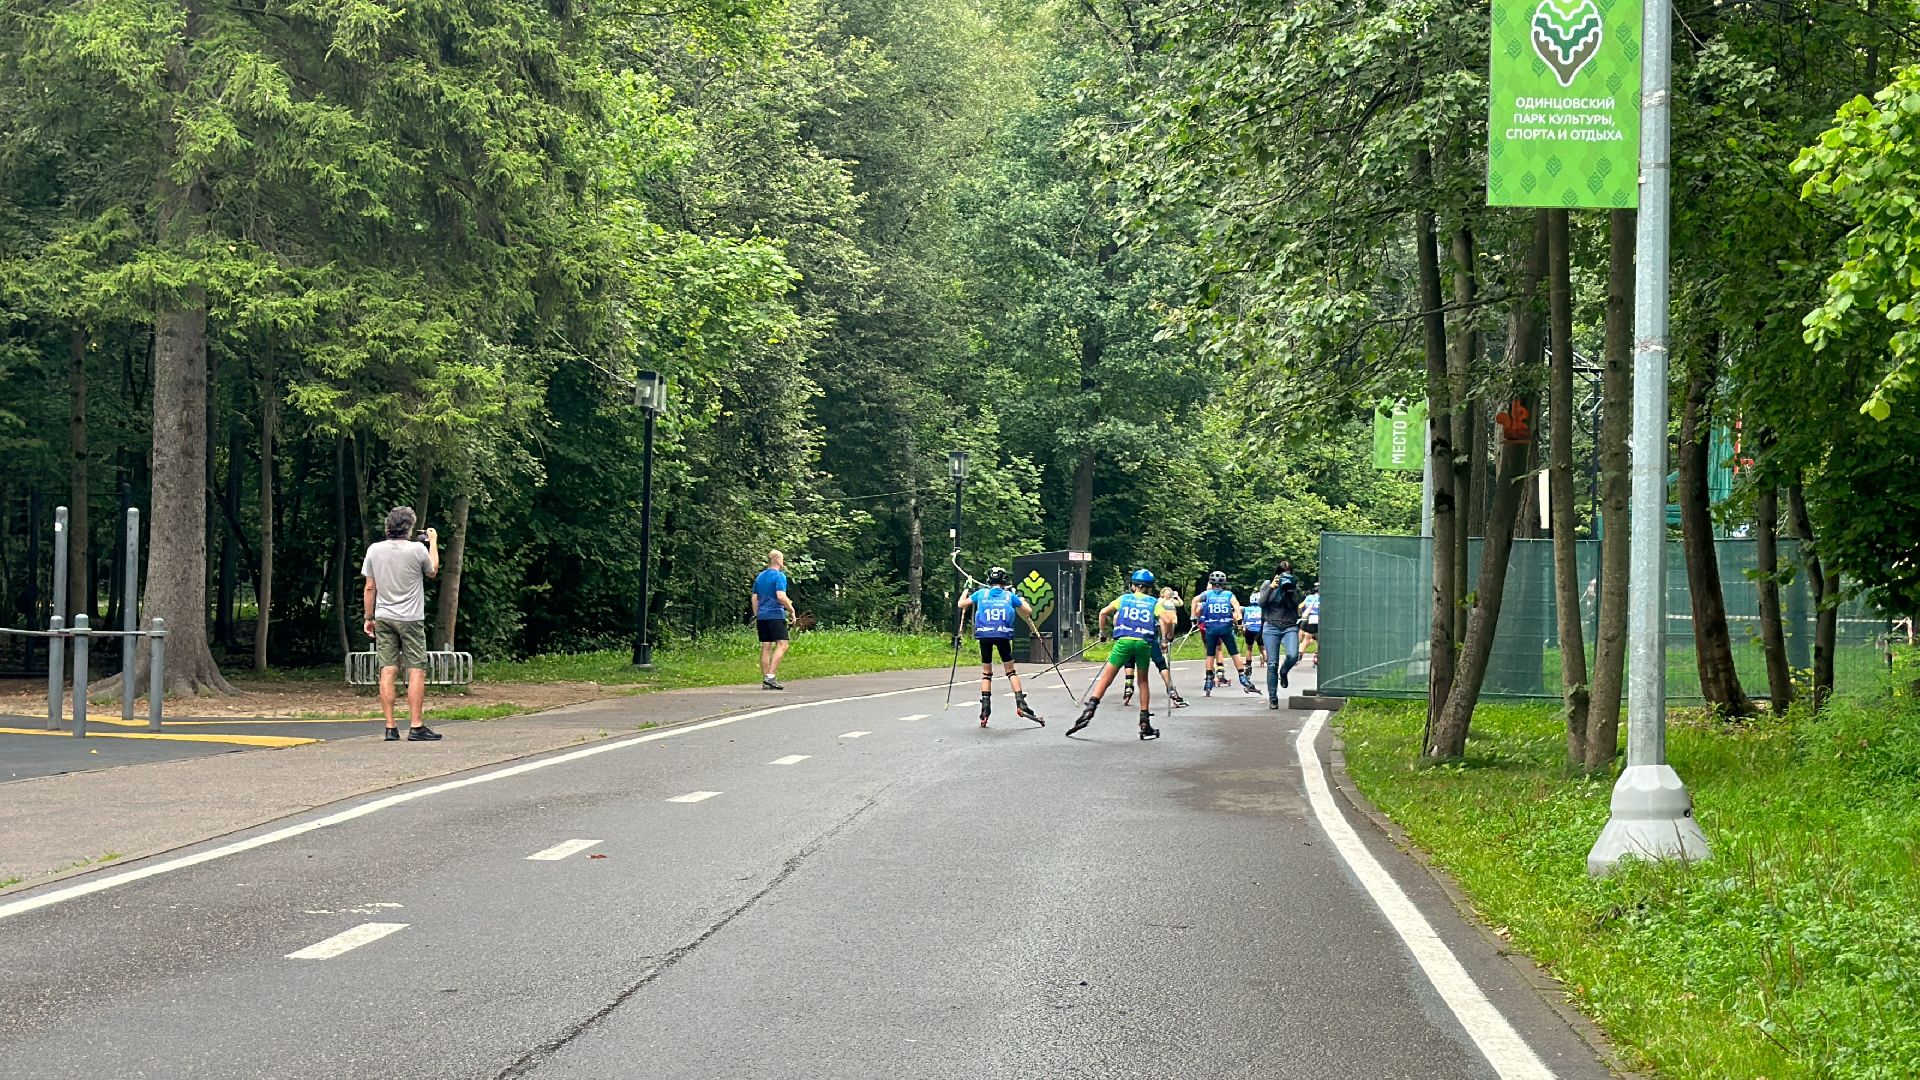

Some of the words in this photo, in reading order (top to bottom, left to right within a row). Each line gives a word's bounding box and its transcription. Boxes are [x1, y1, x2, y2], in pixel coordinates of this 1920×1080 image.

[1515, 96, 1615, 109] ОДИНЦОВСКИЙ
[1513, 114, 1546, 124] ПАРК
[1548, 114, 1616, 126] КУЛЬТУРЫ,
[1505, 129, 1555, 140] СПОРТА
[1557, 129, 1567, 140] И
[1569, 129, 1623, 142] ОТДЫХА
[1391, 420, 1407, 464] МЕСТО
[984, 608, 1006, 621] 191
[1122, 606, 1151, 623] 183
[1208, 603, 1229, 614] 185
